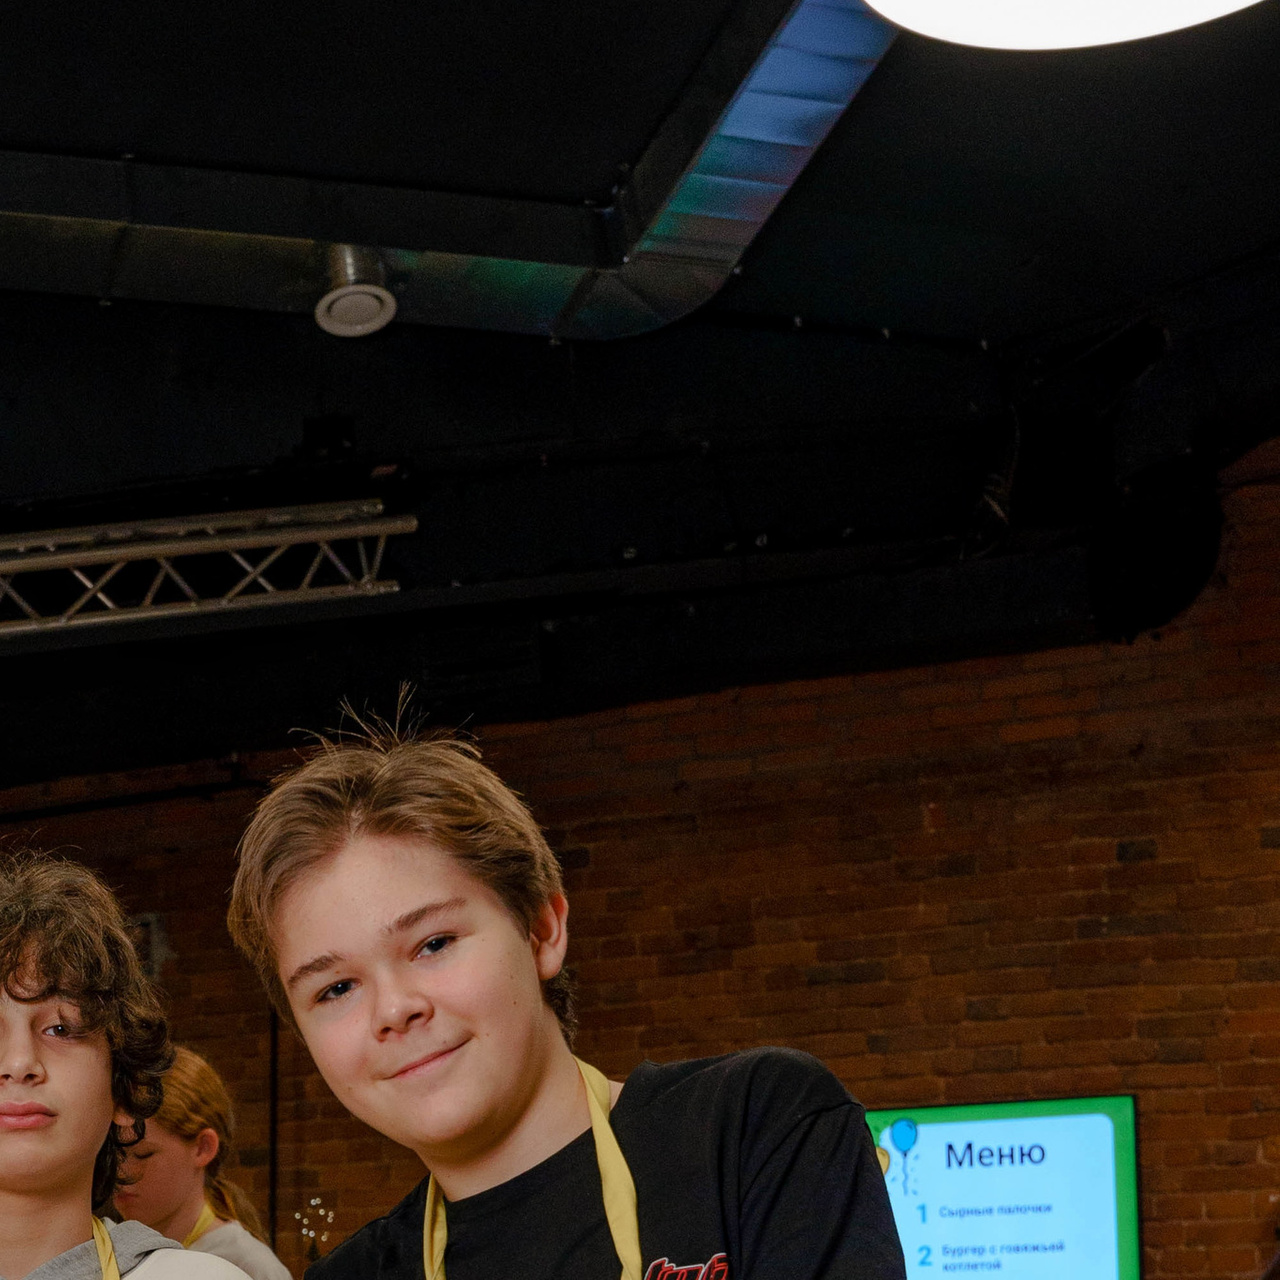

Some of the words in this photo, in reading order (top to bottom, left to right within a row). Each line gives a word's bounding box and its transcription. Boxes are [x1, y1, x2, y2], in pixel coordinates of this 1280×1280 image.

[945, 1142, 1045, 1168] Меню
[916, 1203, 927, 1224] 1
[939, 1206, 994, 1219] Сырные
[998, 1203, 1053, 1215] палочки
[918, 1245, 932, 1267] 2
[942, 1244, 987, 1258] Бургер
